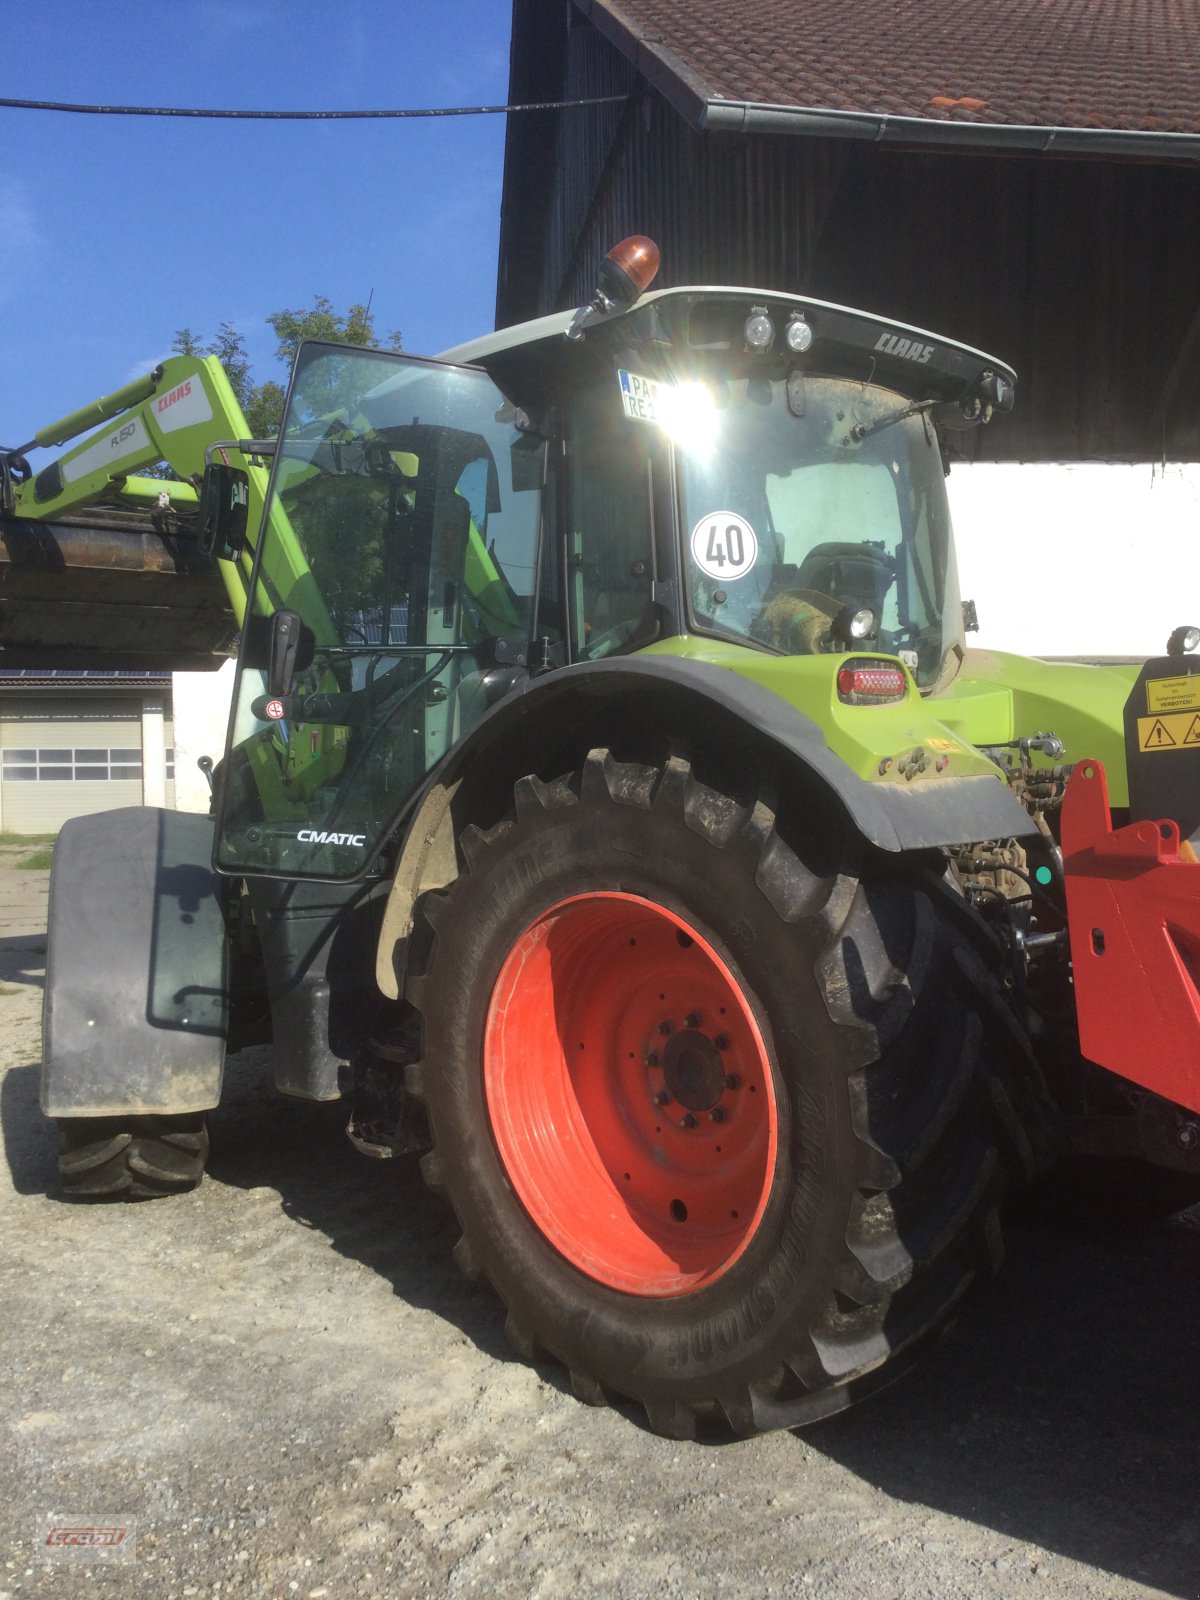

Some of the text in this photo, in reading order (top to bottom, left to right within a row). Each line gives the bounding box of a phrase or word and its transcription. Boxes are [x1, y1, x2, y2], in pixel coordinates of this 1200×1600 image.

[874, 332, 935, 364] CLAAS
[158, 381, 192, 412] CLAAS
[631, 375, 651, 399] PA
[705, 523, 745, 567] 40
[1162, 681, 1188, 689] Aufenthalt
[1159, 700, 1193, 708] VERBOTEN!
[296, 829, 367, 847] CMATIC
